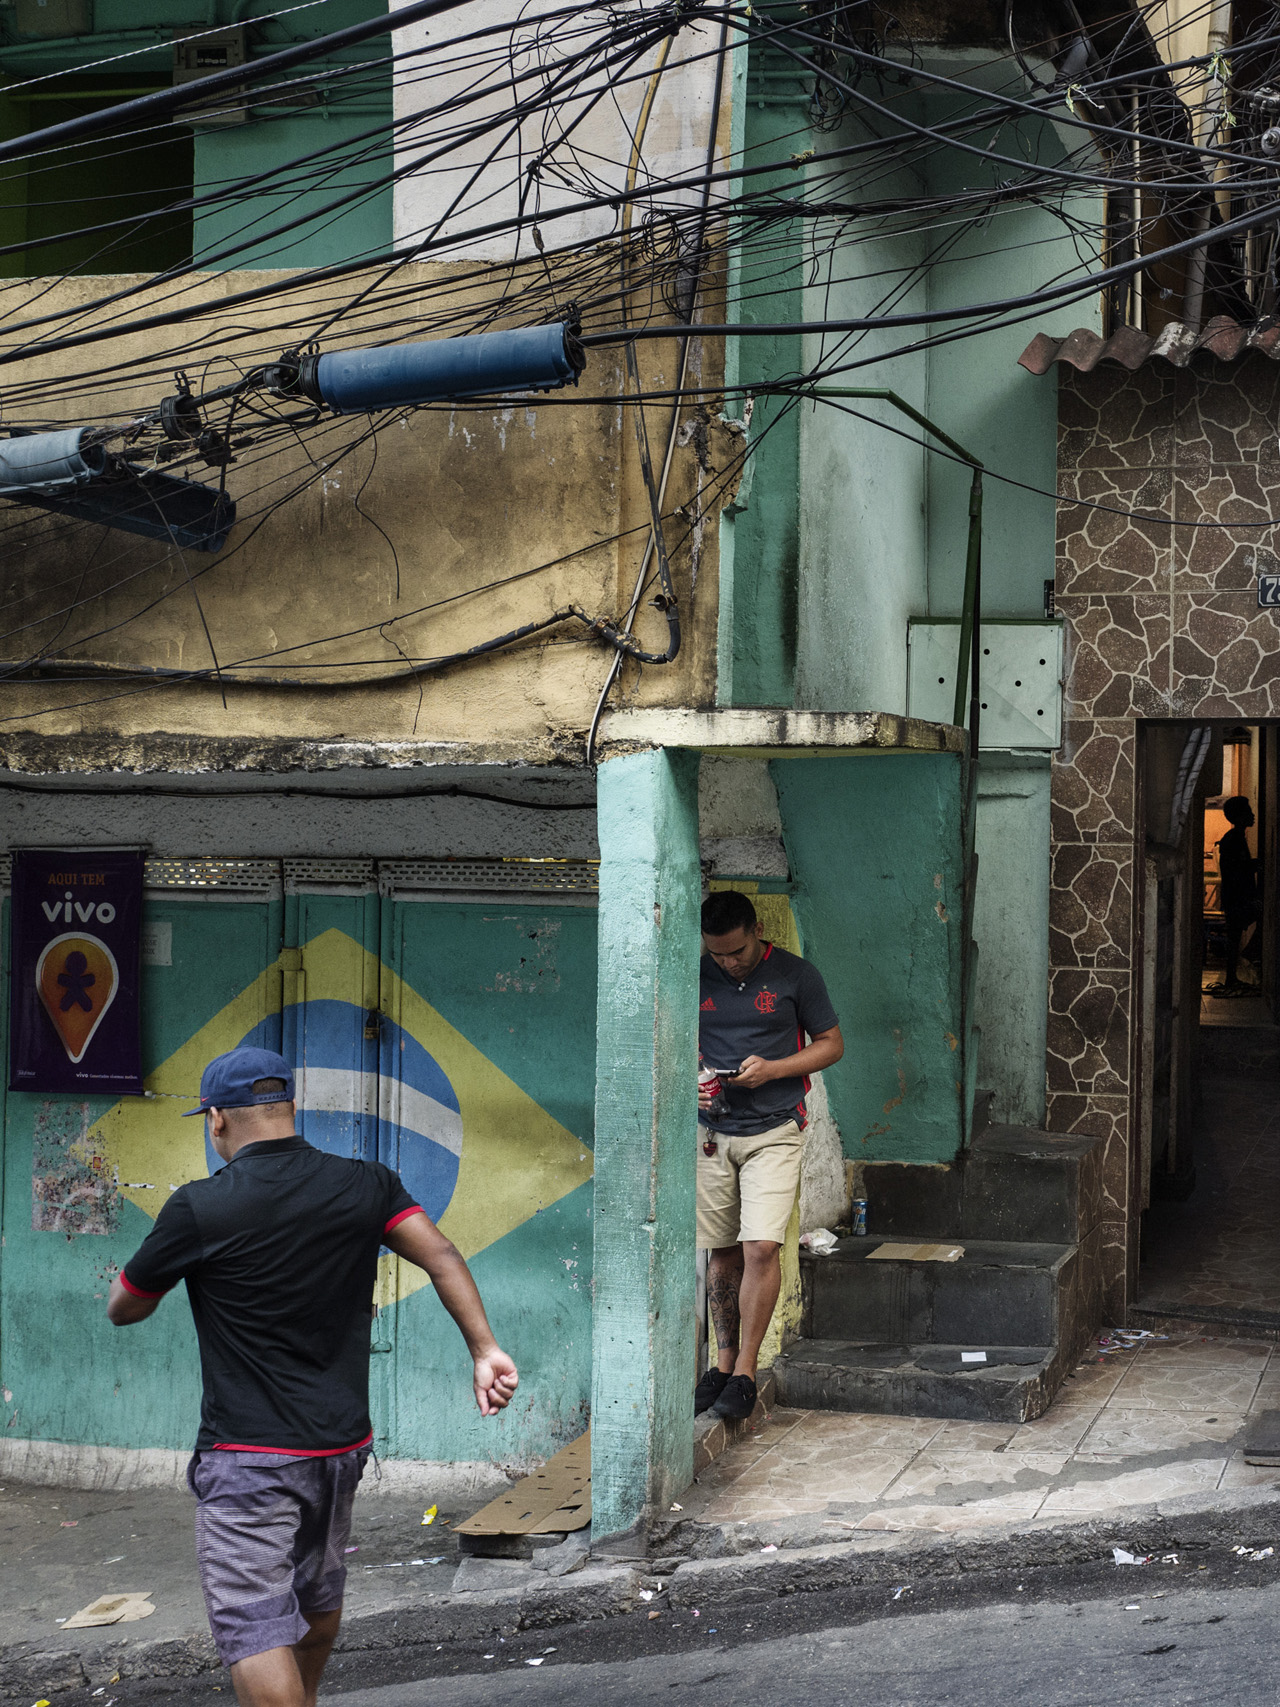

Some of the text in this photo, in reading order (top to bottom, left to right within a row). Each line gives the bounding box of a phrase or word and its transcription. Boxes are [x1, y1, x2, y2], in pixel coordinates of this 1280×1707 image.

[48, 872, 105, 886] AQUI TEM
[41, 891, 116, 924] vivo
